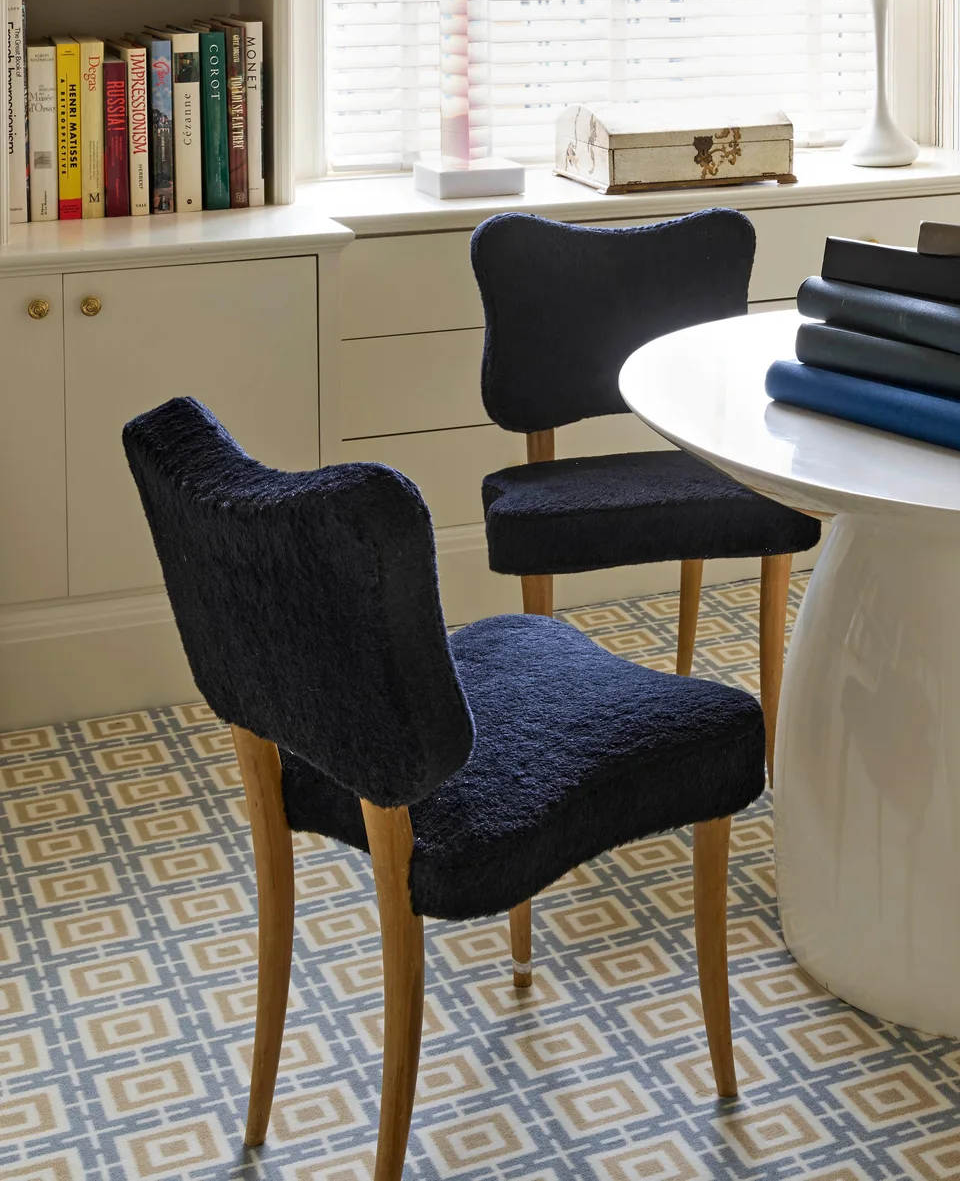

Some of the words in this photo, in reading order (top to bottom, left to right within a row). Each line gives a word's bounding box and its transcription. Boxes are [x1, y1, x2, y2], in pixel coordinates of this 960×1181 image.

[84, 56, 101, 92] Degas
[209, 44, 220, 101] COROT
[246, 36, 257, 91] MONET
[69, 84, 77, 118] HENRI
[106, 81, 126, 132] RUSSIA!
[130, 53, 147, 155] IMPRESSIONISM
[182, 93, 193, 146] Cézanne
[69, 122, 78, 169] MATISSE
